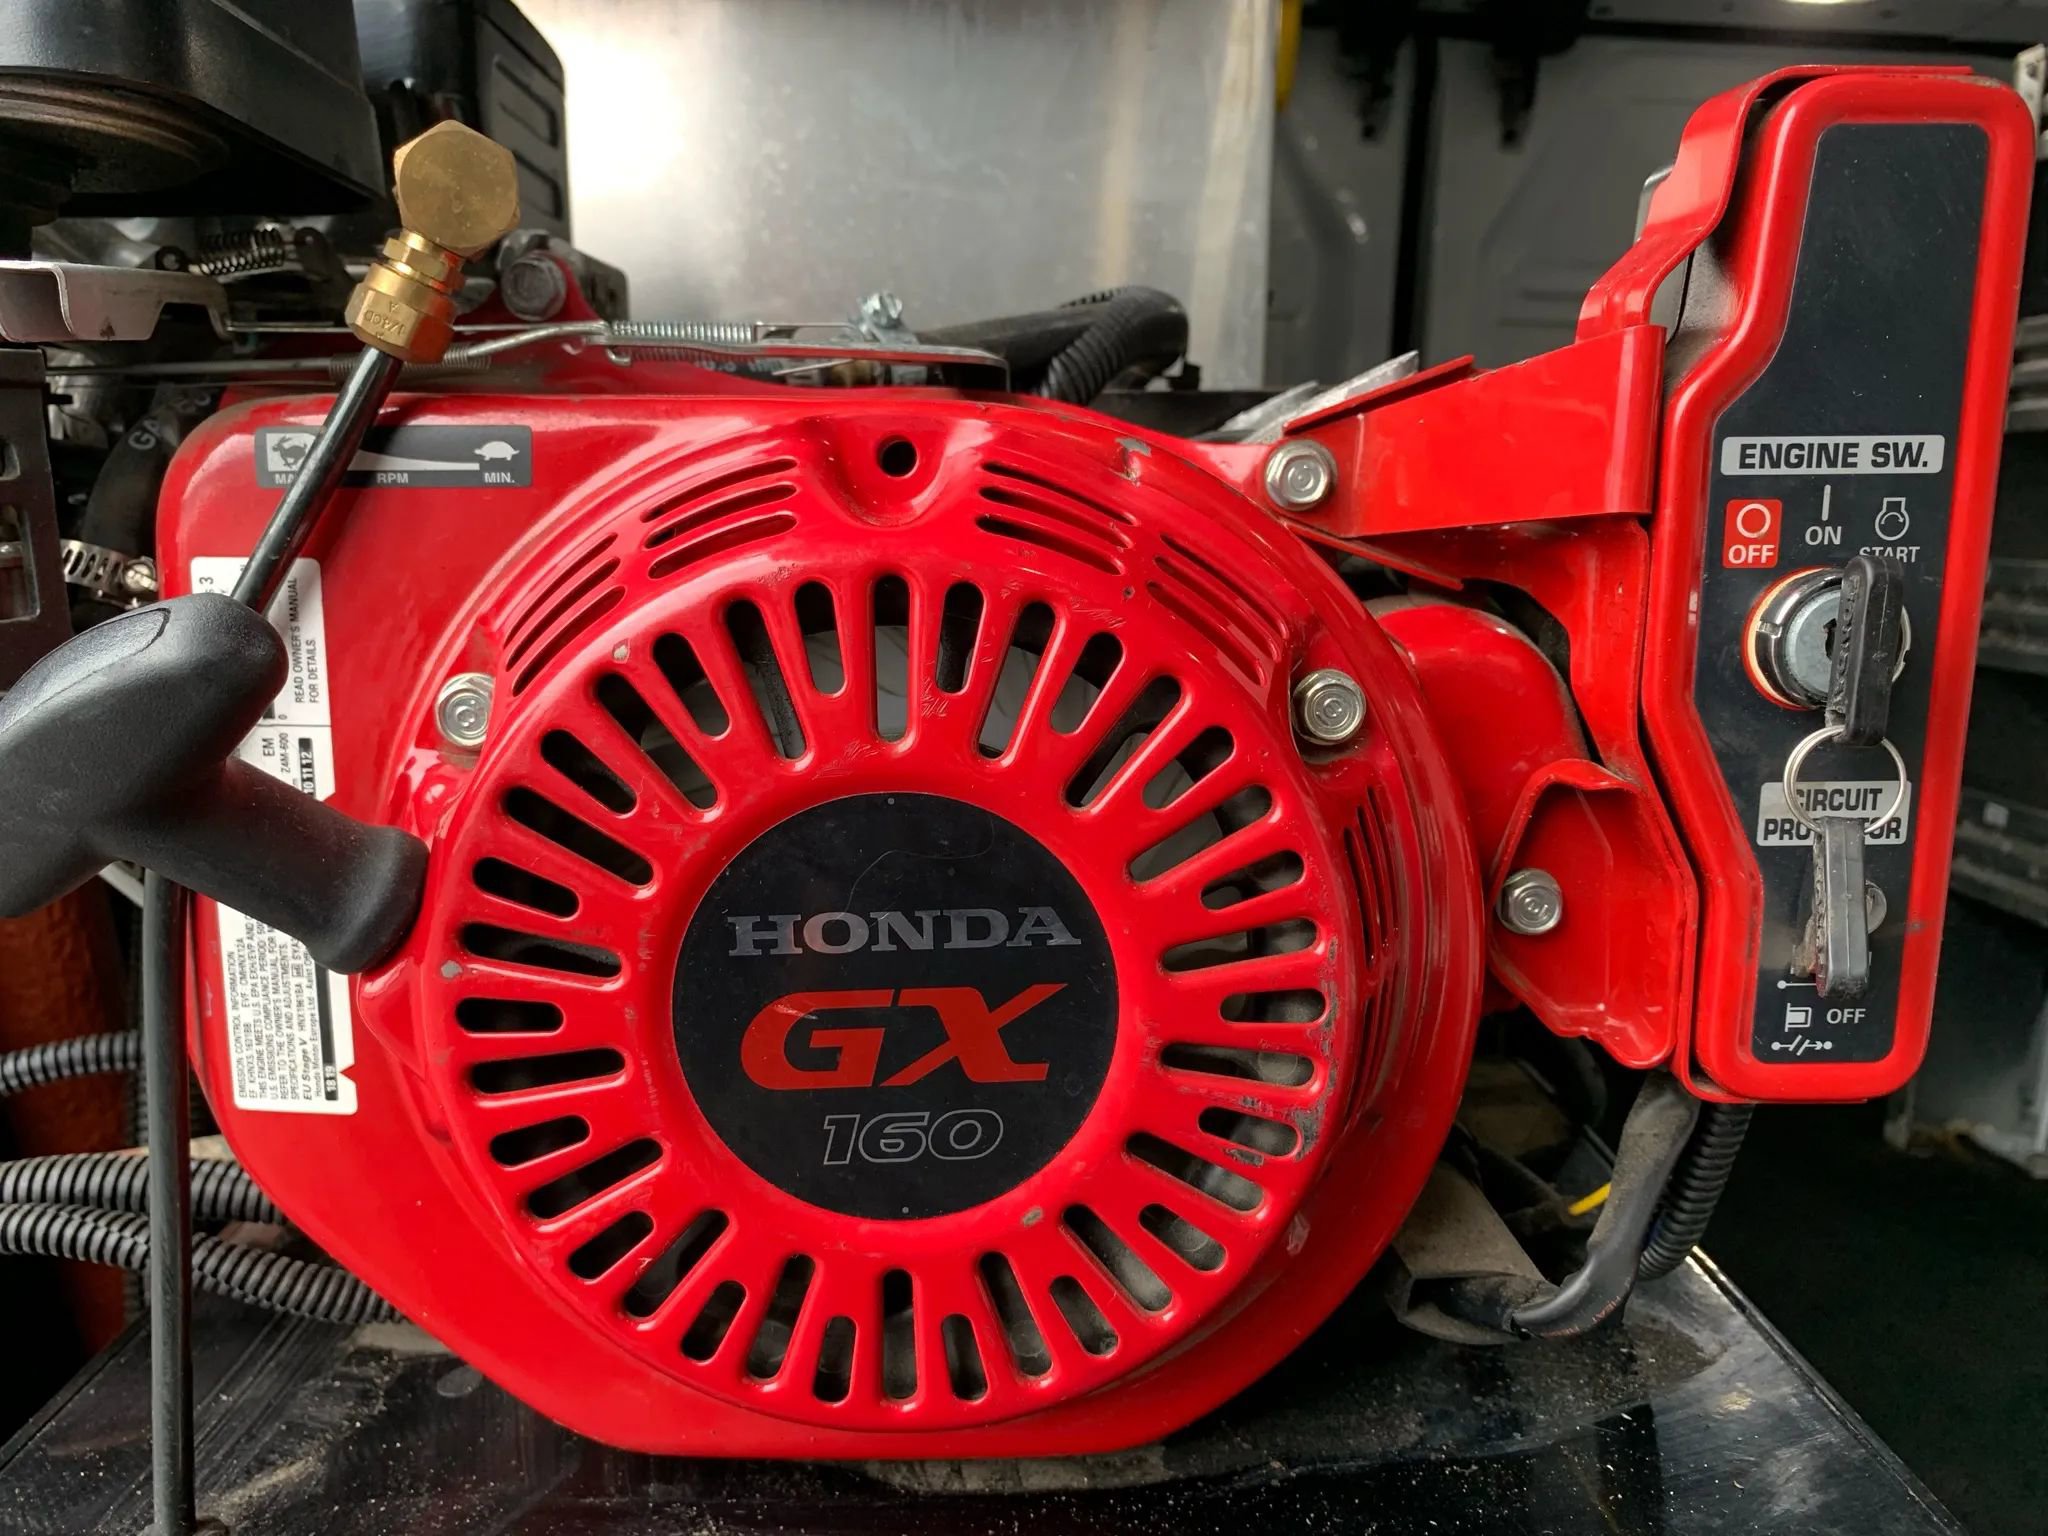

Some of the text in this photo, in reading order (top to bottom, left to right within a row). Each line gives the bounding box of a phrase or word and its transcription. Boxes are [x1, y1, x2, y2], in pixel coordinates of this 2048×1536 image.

[1739, 442, 1928, 469] ENGINE SW.
[274, 474, 298, 485] MA
[376, 473, 409, 484] RPM
[484, 472, 515, 483] MIN.
[1805, 526, 1842, 545] ON
[1728, 544, 1775, 564] OFF
[288, 578, 304, 703] READ OWNER'S MANUAL
[307, 640, 319, 703] FOR DETAILS
[262, 738, 275, 756] EM
[302, 752, 314, 793] 10 11 12
[245, 923, 255, 940] AND
[728, 906, 1082, 957] HONDA
[268, 936, 277, 953] FOR
[270, 957, 280, 994] MANUAL
[251, 982, 259, 997] EPA
[261, 976, 273, 1030] COMPLIANCE
[307, 997, 315, 1010] Ltd
[227, 951, 247, 1097] EMISSION CONTROL INFORMATION
[273, 999, 284, 1037] OWNER'S
[285, 1011, 294, 1029] AND
[308, 1013, 319, 1041] Europe
[1826, 1008, 1866, 1024] OFF
[253, 1018, 263, 1045] MEETS
[299, 1037, 307, 1045] V
[740, 983, 1069, 1090] GX
[266, 1034, 277, 1080] EMISSIONS
[276, 1040, 285, 1056] THE
[311, 1044, 320, 1069] Motor
[256, 1049, 266, 1078] ENGINE
[278, 1059, 286, 1070] TO
[287, 1033, 300, 1100] SPECIFICATIONS
[300, 1049, 313, 1081] Stage
[259, 1081, 268, 1098] THIS
[279, 1075, 289, 1099] REFER
[303, 1084, 312, 1100] EU
[313, 1072, 322, 1096] Honda
[326, 1079, 336, 1092] 18
[823, 1108, 1004, 1165] 160
